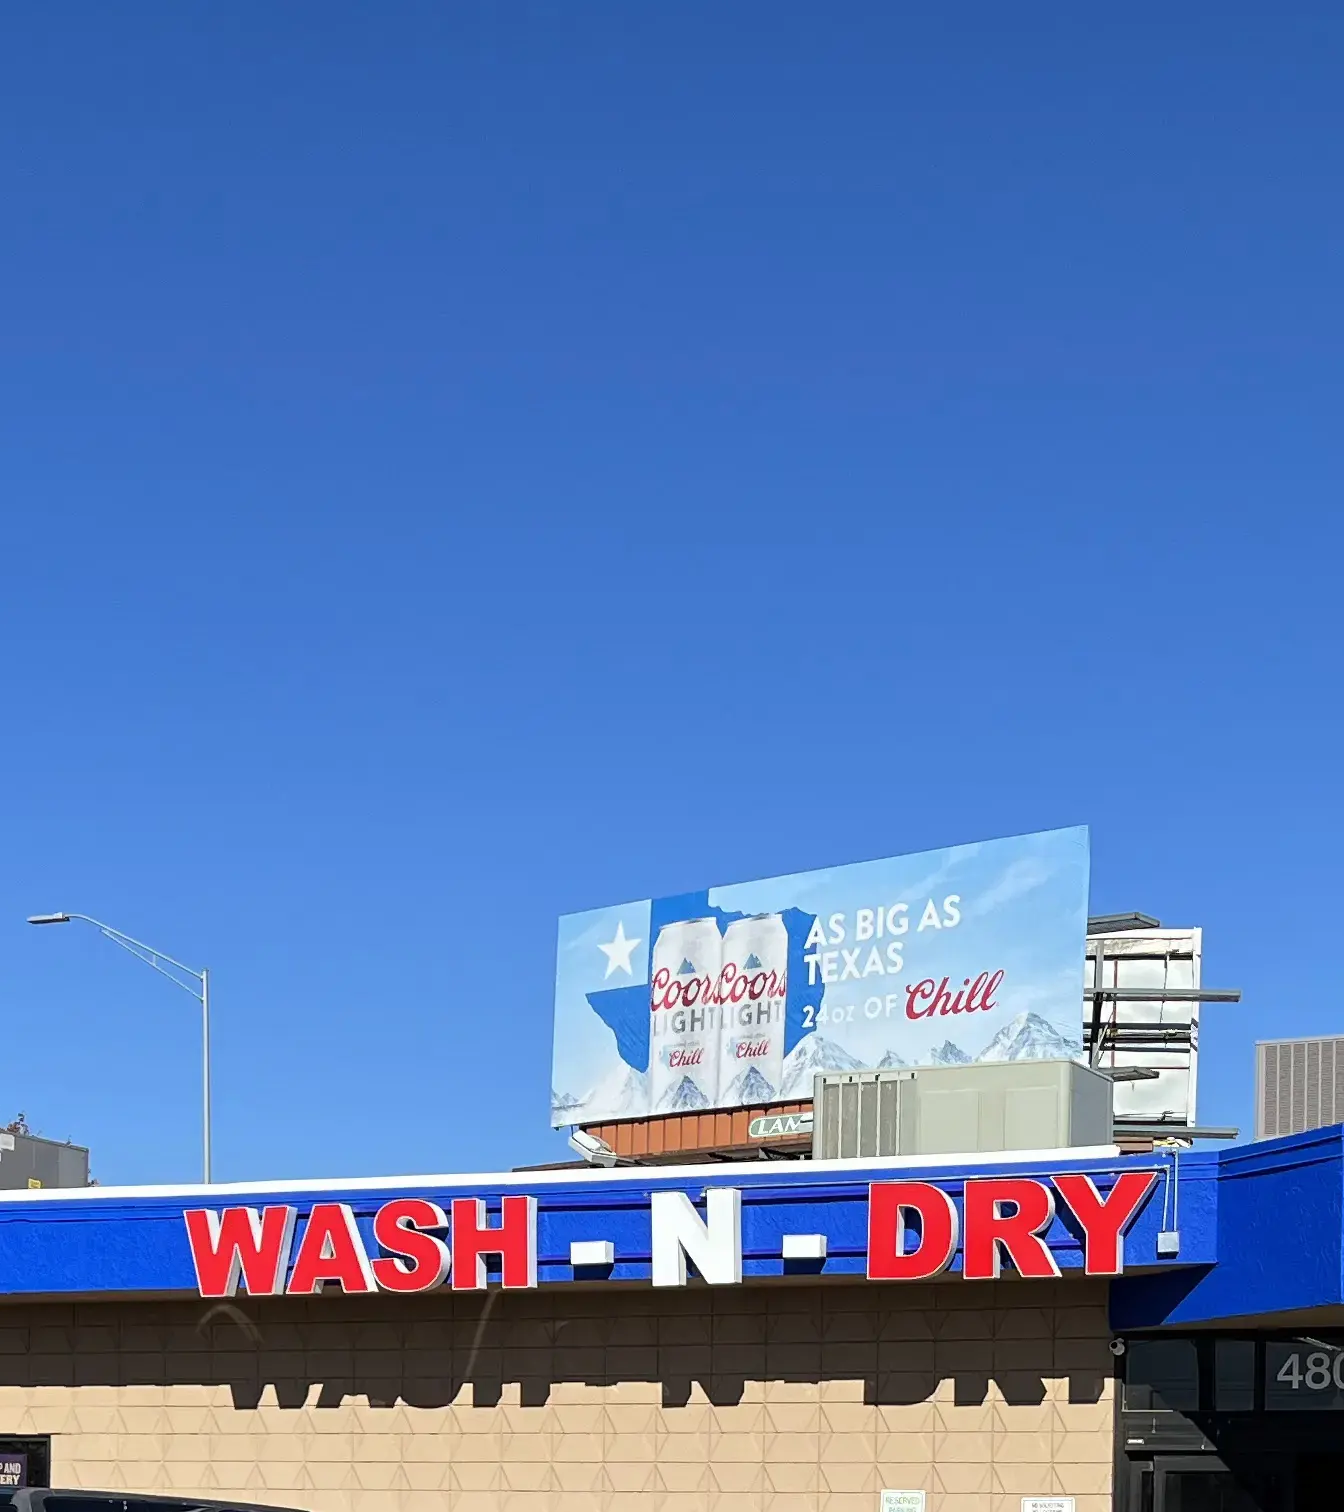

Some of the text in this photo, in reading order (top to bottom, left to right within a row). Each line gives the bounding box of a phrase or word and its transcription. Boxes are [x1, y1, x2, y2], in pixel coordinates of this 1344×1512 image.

[804, 894, 961, 950] AS BIG AS
[803, 941, 905, 986] TEXAS
[719, 961, 787, 1005] Coors
[905, 969, 1005, 1020] Chill
[653, 1005, 717, 1037] LIGHT
[720, 1000, 783, 1030] LIGHT
[864, 993, 899, 1021] OF
[669, 1048, 704, 1068] Chill
[735, 1039, 770, 1059] Chill
[183, 1195, 537, 1298] WASH
[651, 1187, 742, 1287] N
[867, 1171, 1158, 1281] DRY
[3, 1462, 21, 1474] AND
